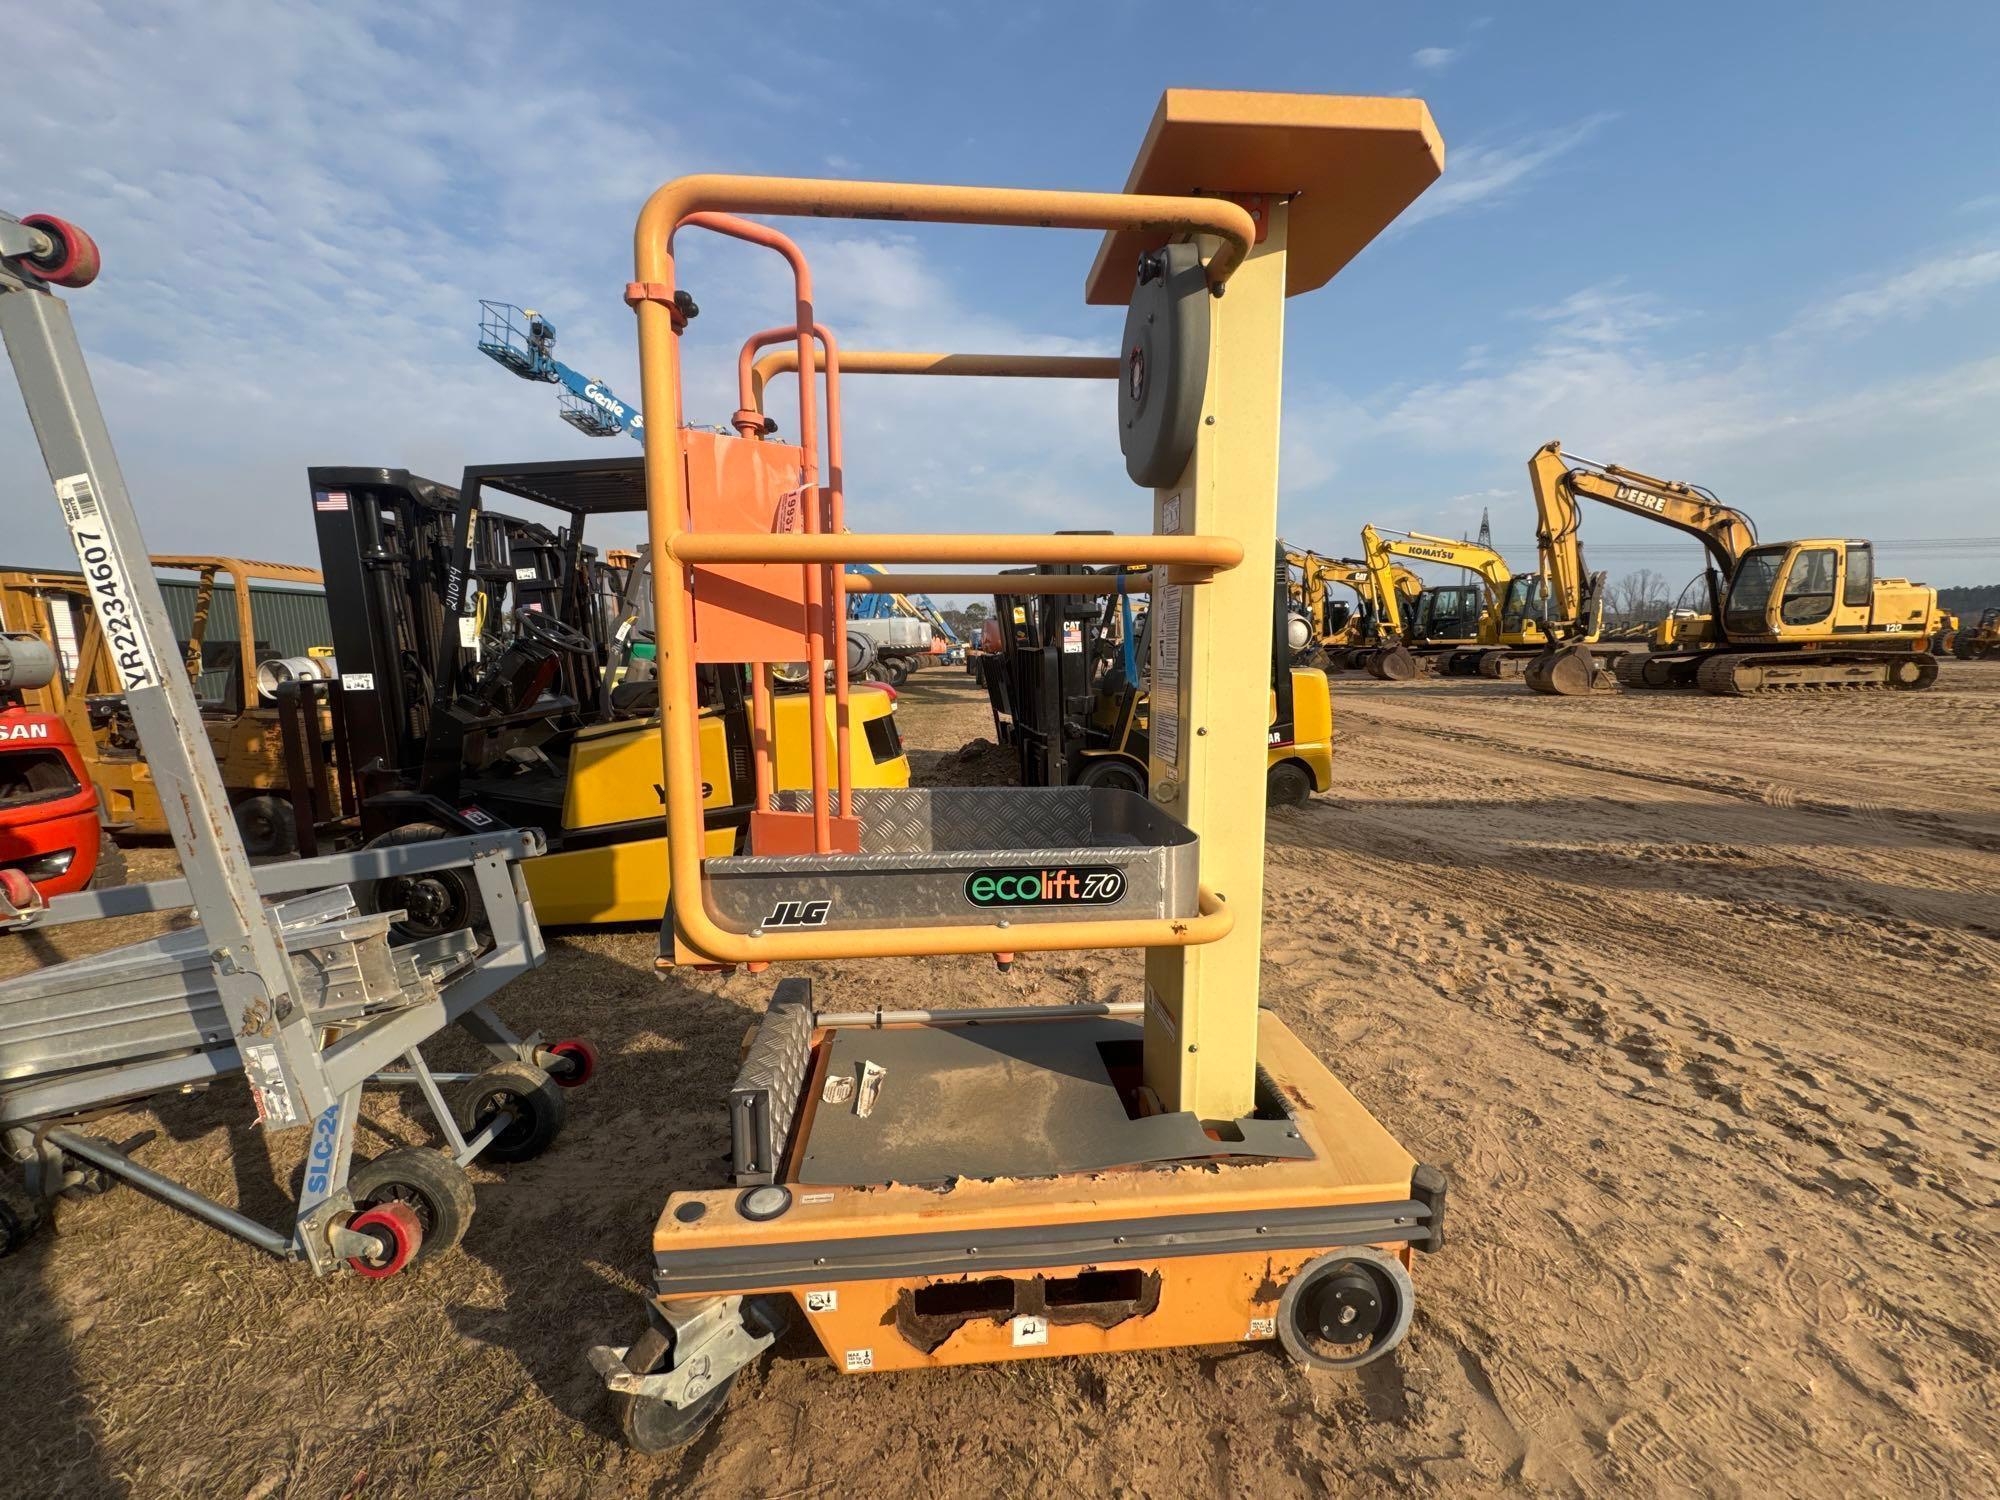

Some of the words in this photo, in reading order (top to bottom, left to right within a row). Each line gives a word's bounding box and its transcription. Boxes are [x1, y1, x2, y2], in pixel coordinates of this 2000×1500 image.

[585, 384, 624, 418] Genie
[1616, 486, 1666, 512] DEERE
[1408, 546, 1455, 560] KOMATSU
[446, 566, 462, 612] 211044
[1355, 572, 1368, 581] CAT
[78, 531, 148, 690] YR2234607
[1063, 621, 1081, 632] CAT
[1886, 623, 1903, 632] 120
[761, 900, 832, 928] JLG
[307, 1104, 340, 1194] SLC-24
